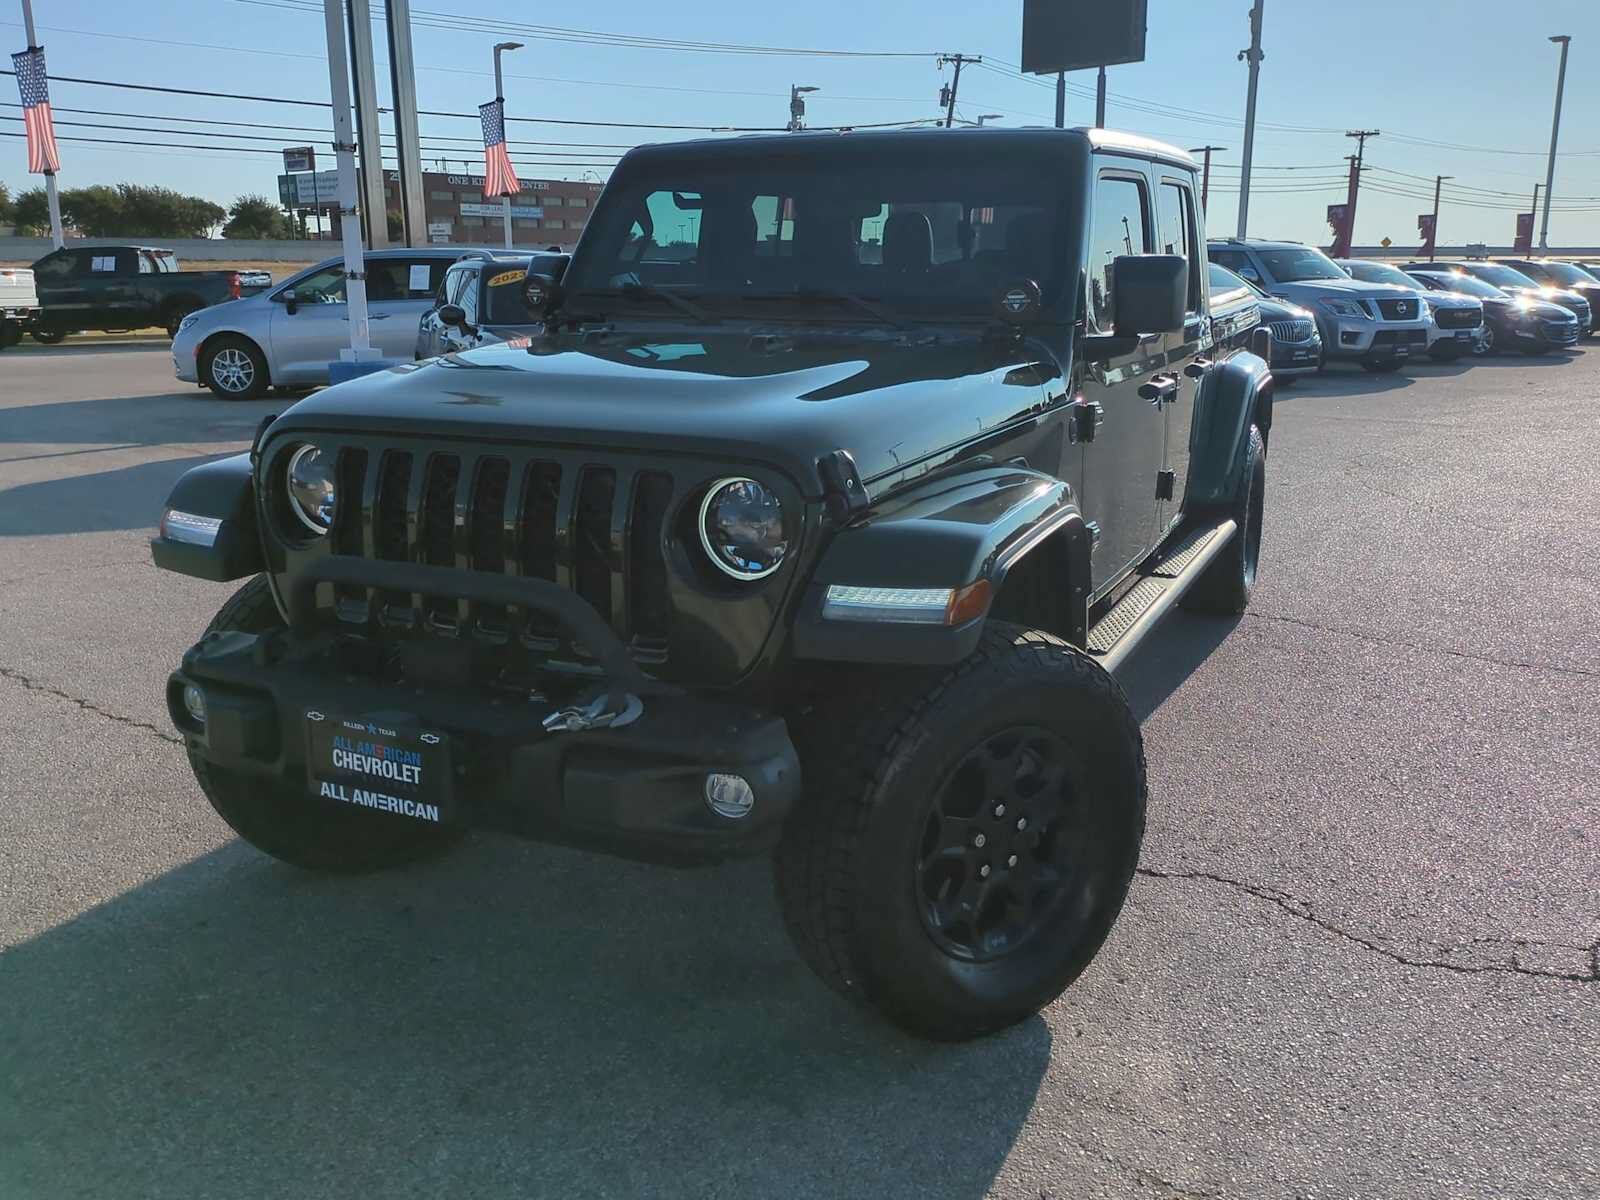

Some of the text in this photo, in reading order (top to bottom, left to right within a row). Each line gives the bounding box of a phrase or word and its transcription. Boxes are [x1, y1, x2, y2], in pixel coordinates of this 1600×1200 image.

[447, 175, 470, 185] ONE
[519, 180, 550, 190] ENTER
[493, 270, 526, 285] 2023
[378, 728, 397, 737] TEXAS
[332, 735, 422, 765] ALL AMERICAN
[332, 748, 422, 785] CHEVROLET
[320, 781, 350, 802] ALL
[352, 788, 439, 822] AMERICAN
